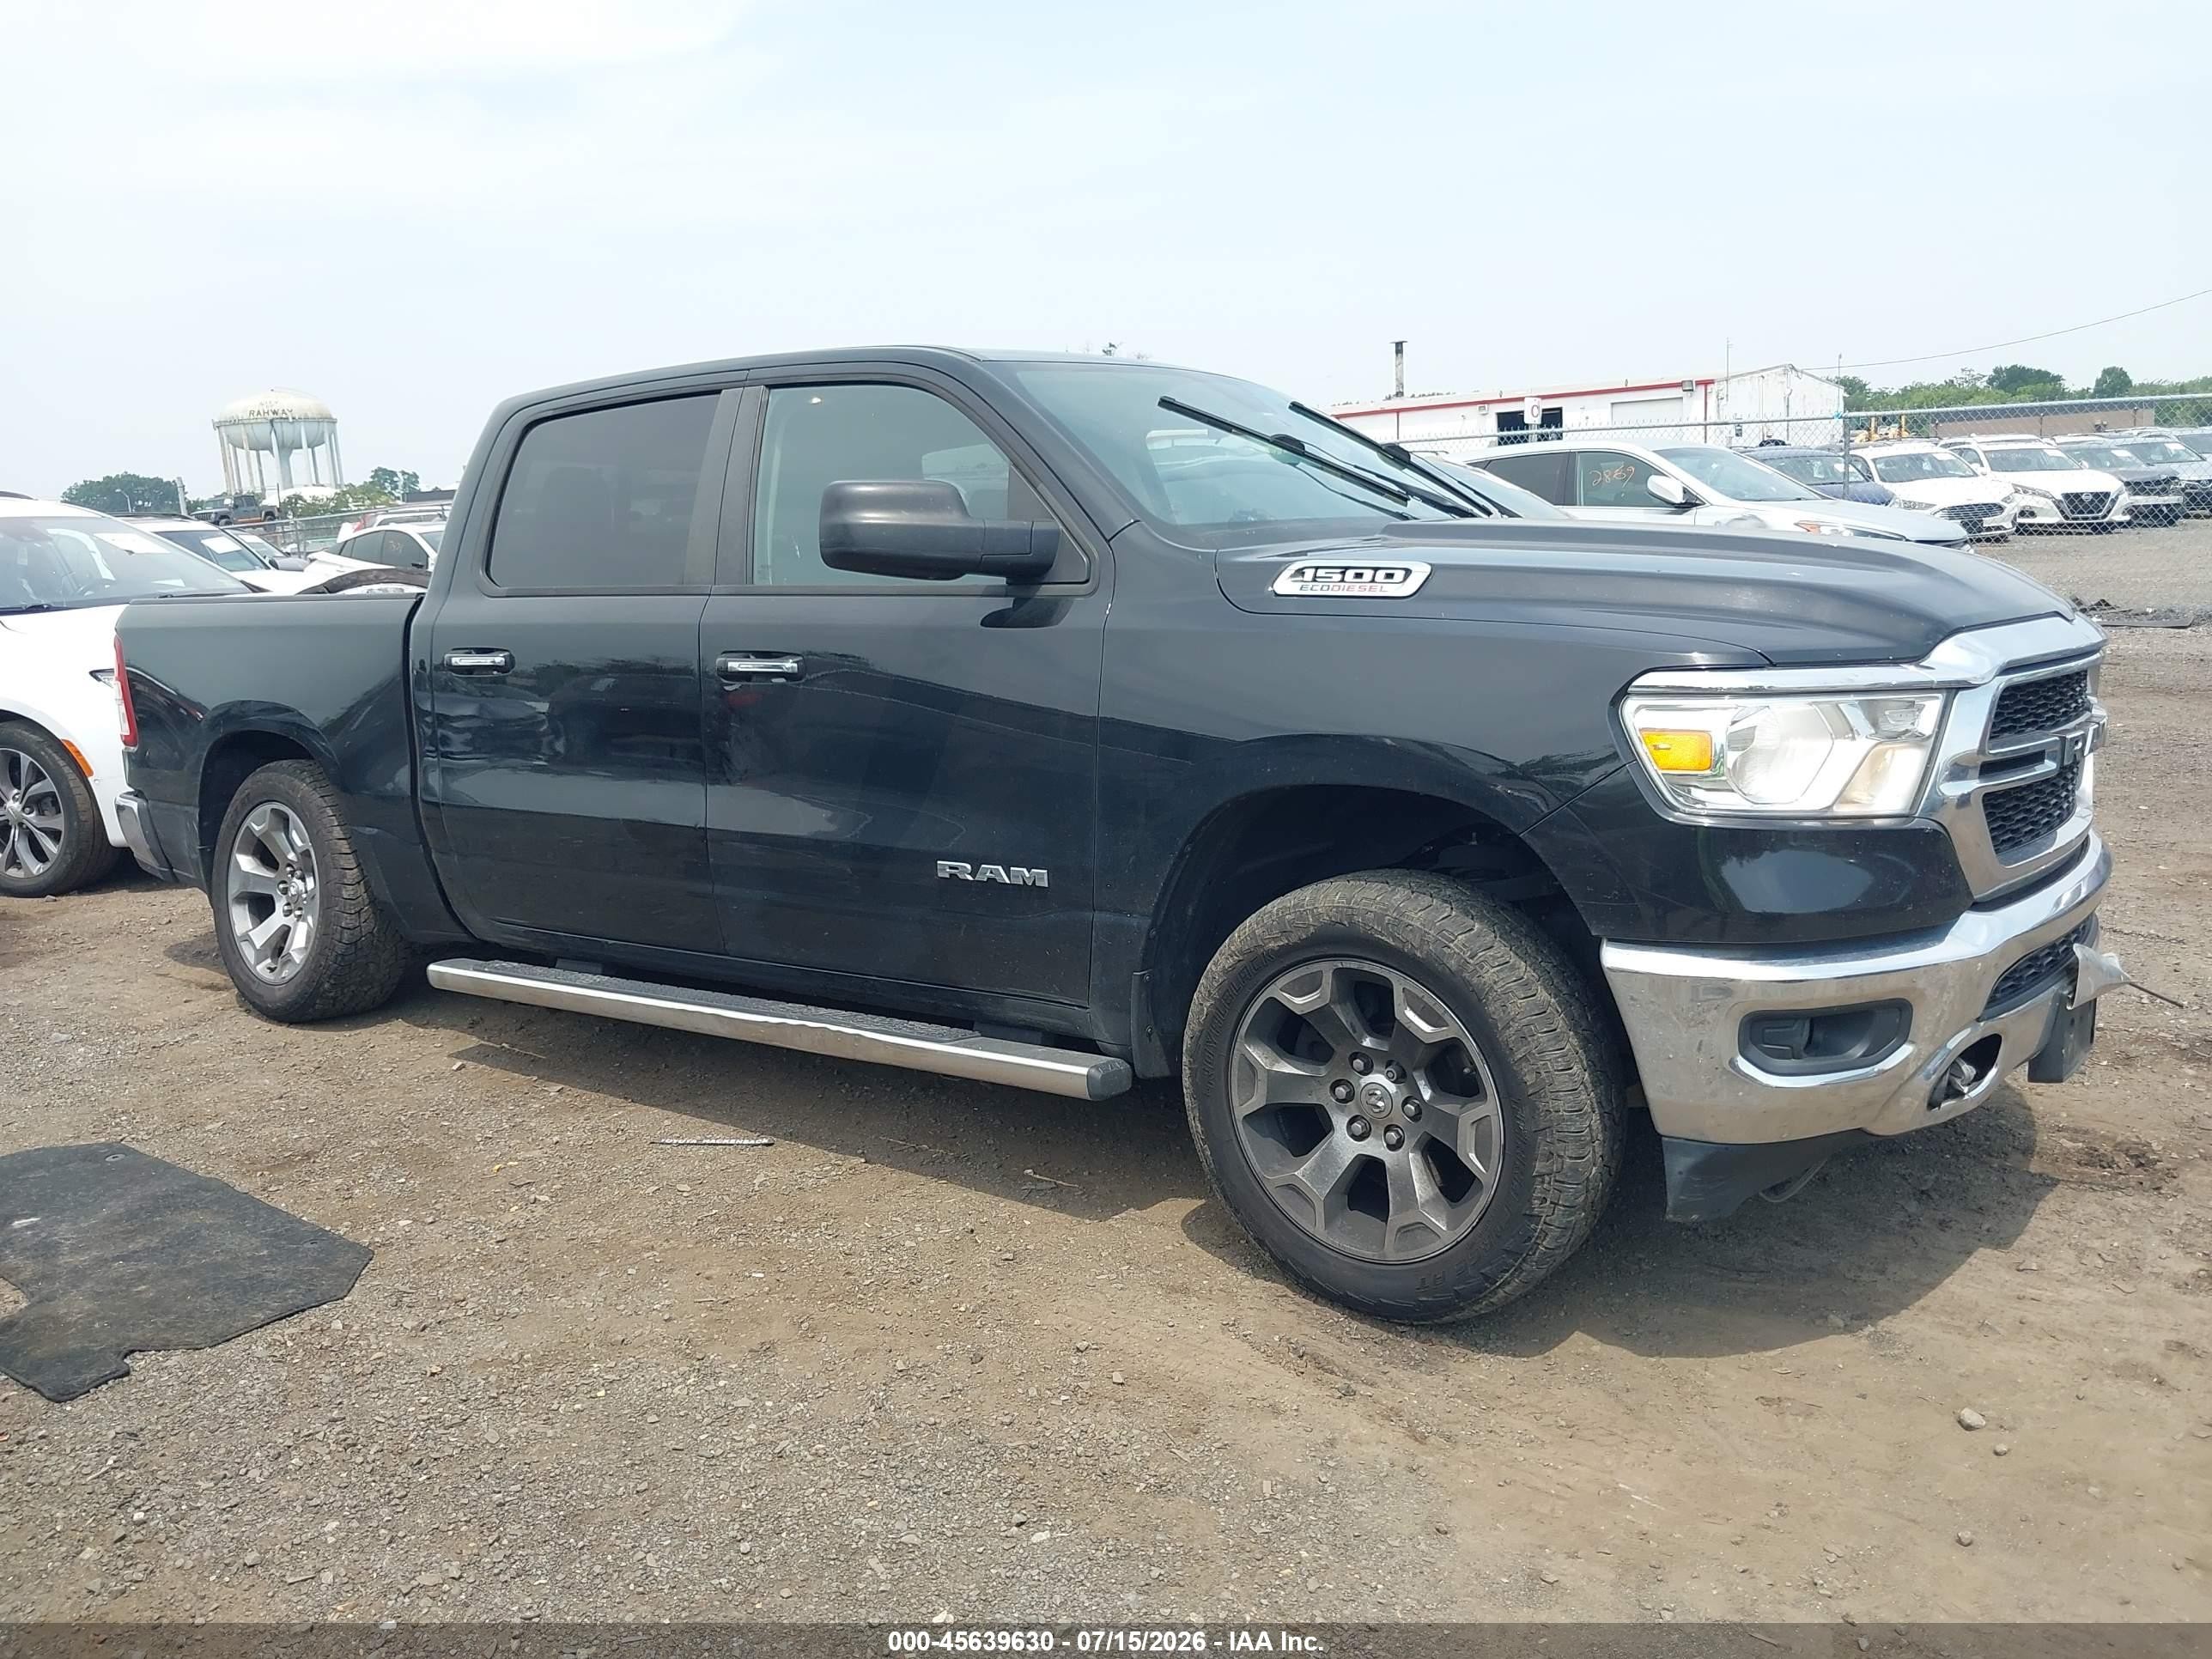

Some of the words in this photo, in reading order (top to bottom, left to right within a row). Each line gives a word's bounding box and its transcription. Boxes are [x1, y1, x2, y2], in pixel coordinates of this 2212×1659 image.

[248, 408, 293, 417] RAHWAY
[1295, 568, 1408, 583] 1500
[1299, 584, 1389, 592] ECODIESEL
[937, 860, 1049, 888] RAM
